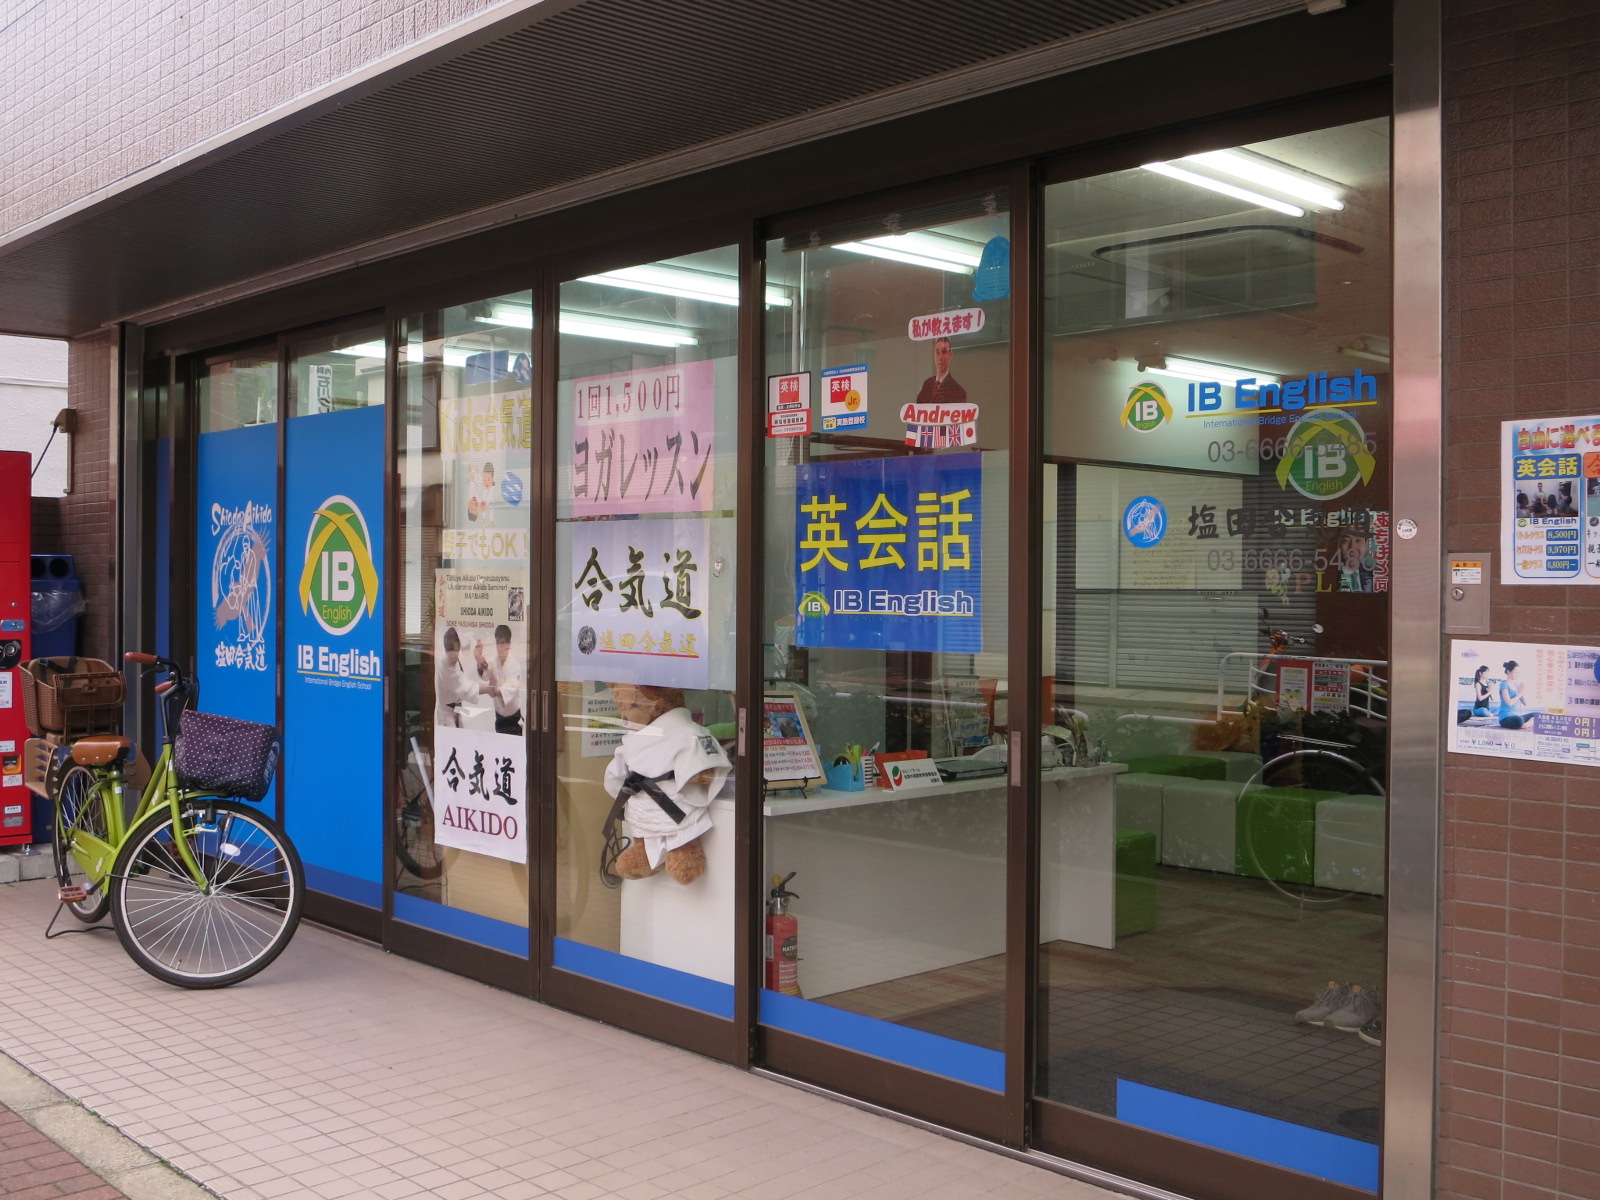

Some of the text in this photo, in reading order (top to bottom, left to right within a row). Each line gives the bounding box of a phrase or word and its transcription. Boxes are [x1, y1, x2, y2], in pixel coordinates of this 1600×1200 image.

[780, 380, 799, 393] 英検
[831, 379, 850, 392] 英検
[1187, 368, 1377, 412] IB English
[903, 404, 977, 424] Andrew
[1135, 400, 1158, 422] IB
[1203, 417, 1255, 429] International
[1258, 415, 1287, 426] Bridge
[574, 427, 713, 503] ヨガレッスン
[1304, 443, 1347, 479] IB
[1517, 456, 1578, 478] 英会話
[1306, 480, 1343, 493] English
[799, 488, 974, 574] 英会話
[1542, 517, 1577, 526] English
[321, 550, 356, 602] IB
[322, 605, 352, 624] English
[807, 588, 974, 616] IB IB English
[297, 644, 381, 677] IB English
[441, 746, 518, 806] 合気道
[442, 804, 518, 840] AIKIDO
